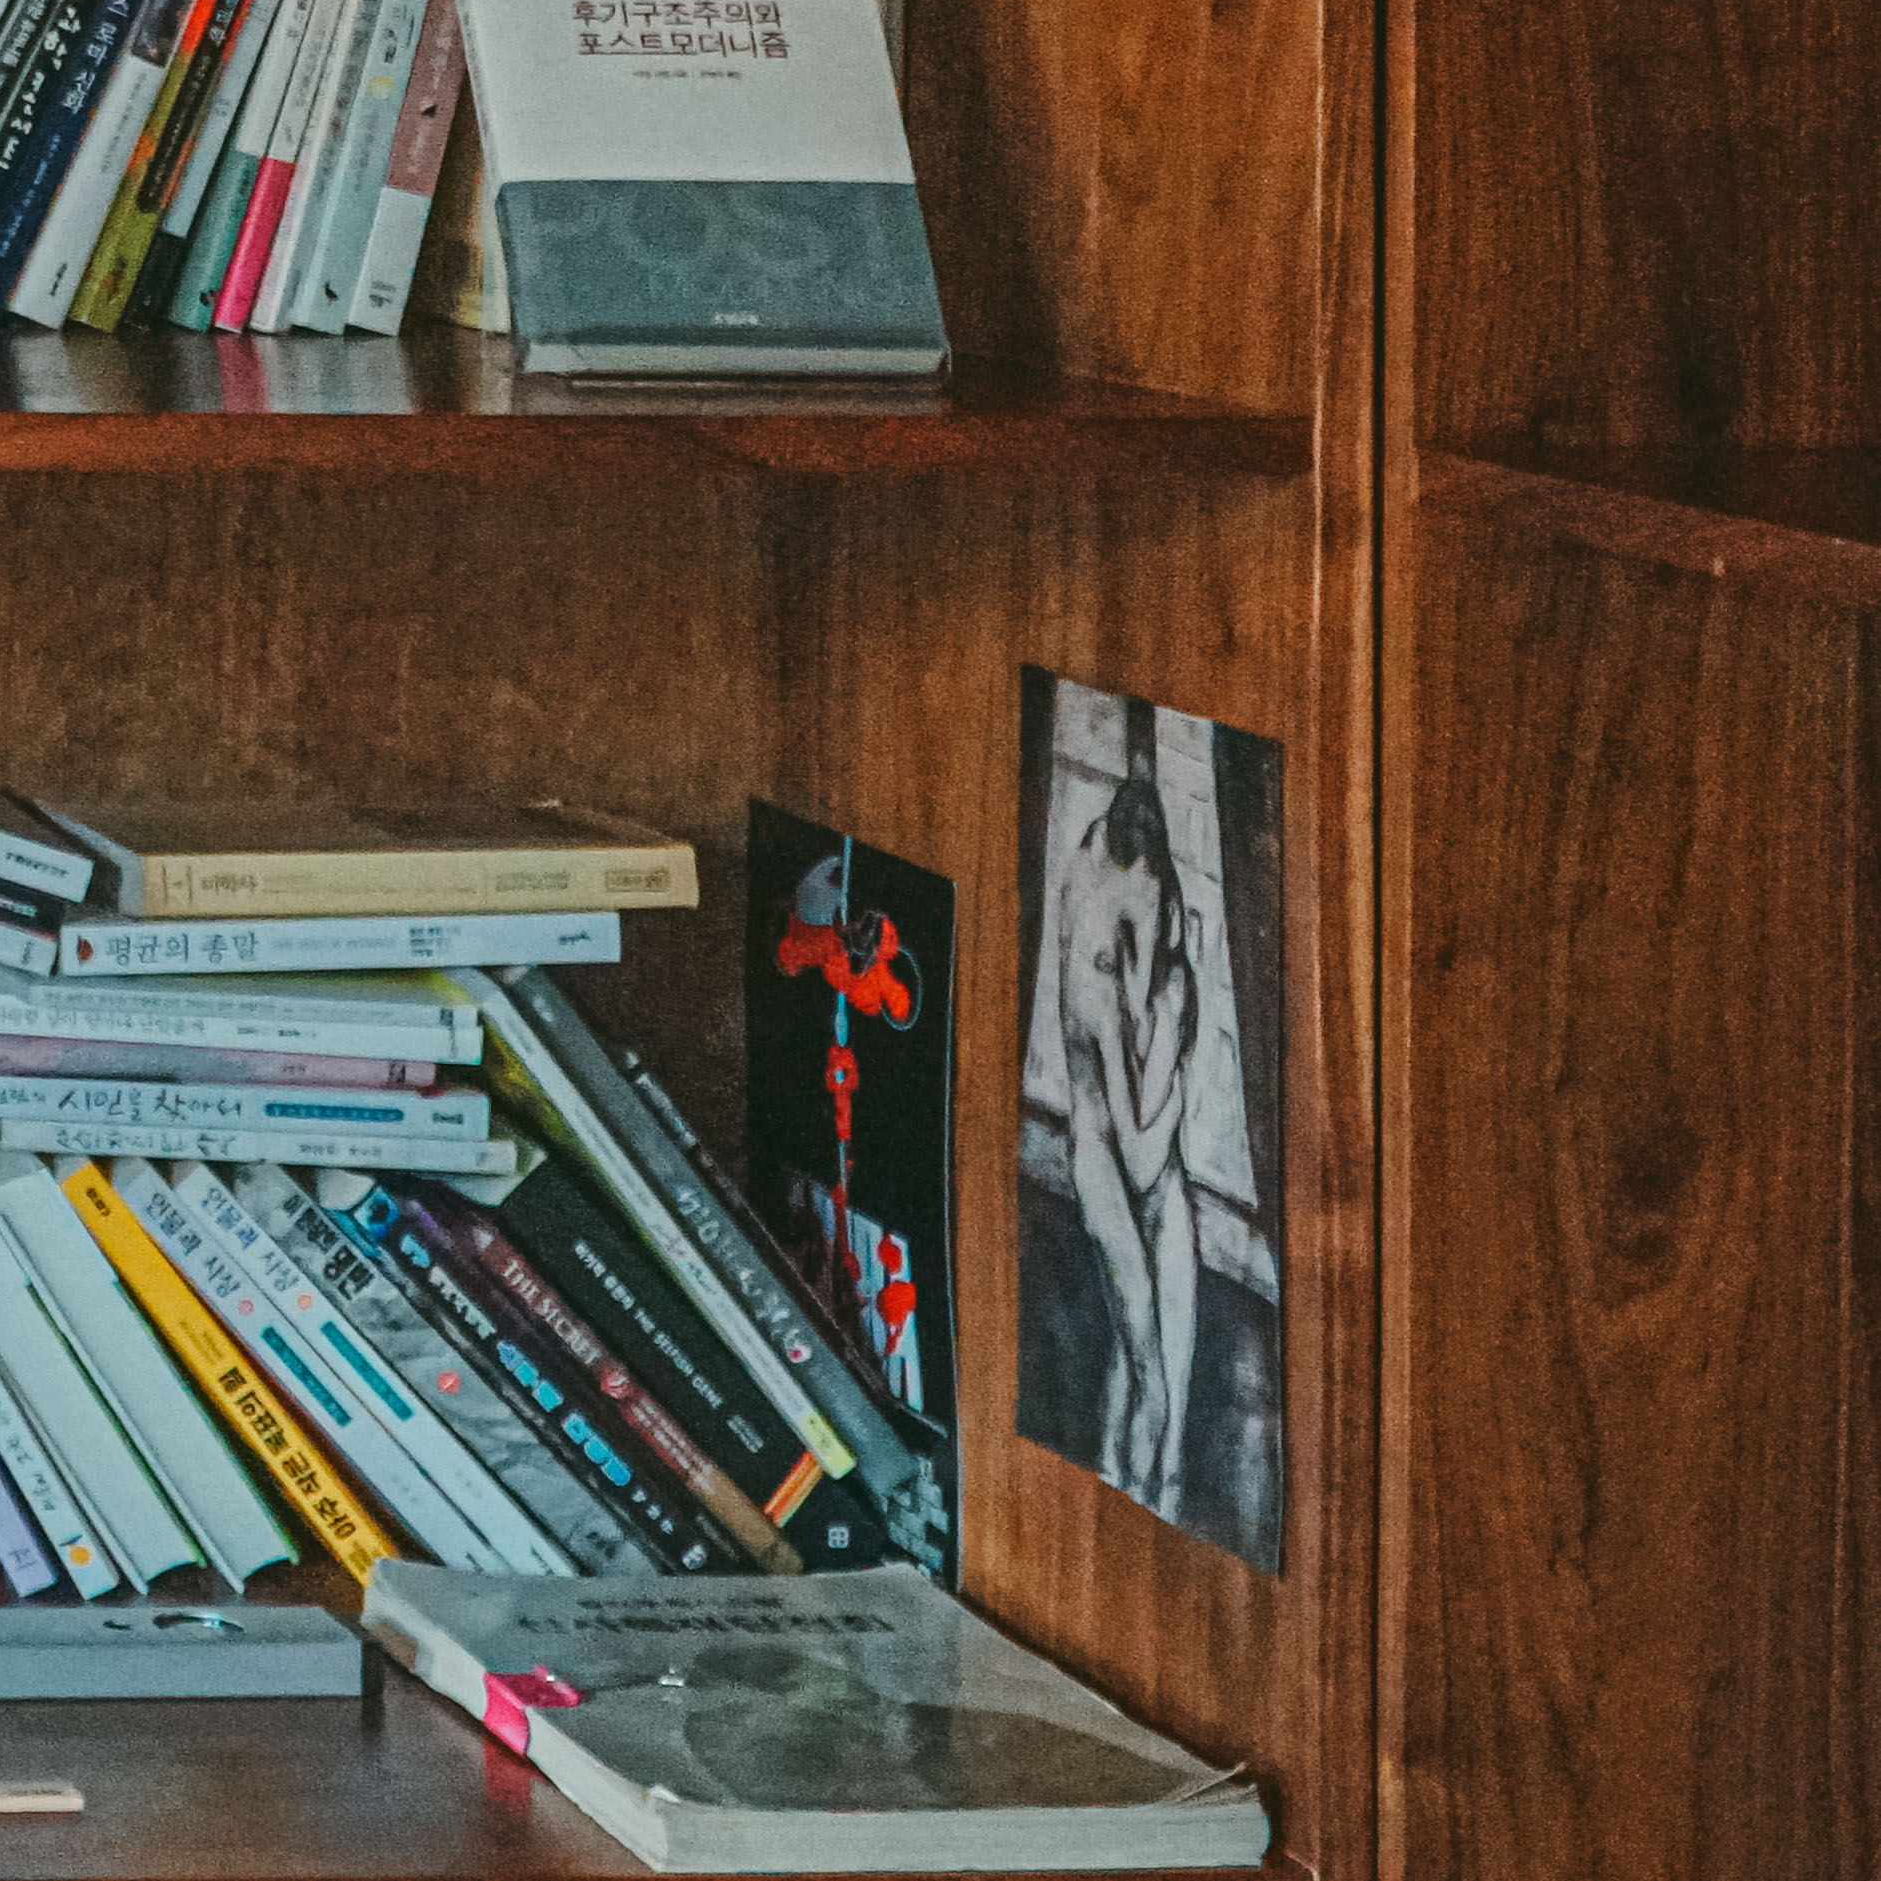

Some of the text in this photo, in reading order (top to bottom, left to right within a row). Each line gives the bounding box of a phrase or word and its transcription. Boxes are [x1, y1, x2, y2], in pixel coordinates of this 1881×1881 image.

[572, 0, 781, 29] 후기구조주의와
[82, 18, 120, 67] 로마
[579, 28, 788, 59] 포스트모더니즘
[57, 65, 99, 118] 신화
[104, 931, 258, 965] 평균의 종말
[58, 1082, 143, 1120] 시인을
[154, 1090, 243, 1123] 찾아서
[142, 1190, 243, 1301] 인물과 사상
[198, 1183, 300, 1296] 인물과 사상
[320, 1244, 375, 1300] 명반
[499, 1258, 601, 1371] THE SECRET
[690, 1373, 724, 1410] GENE
